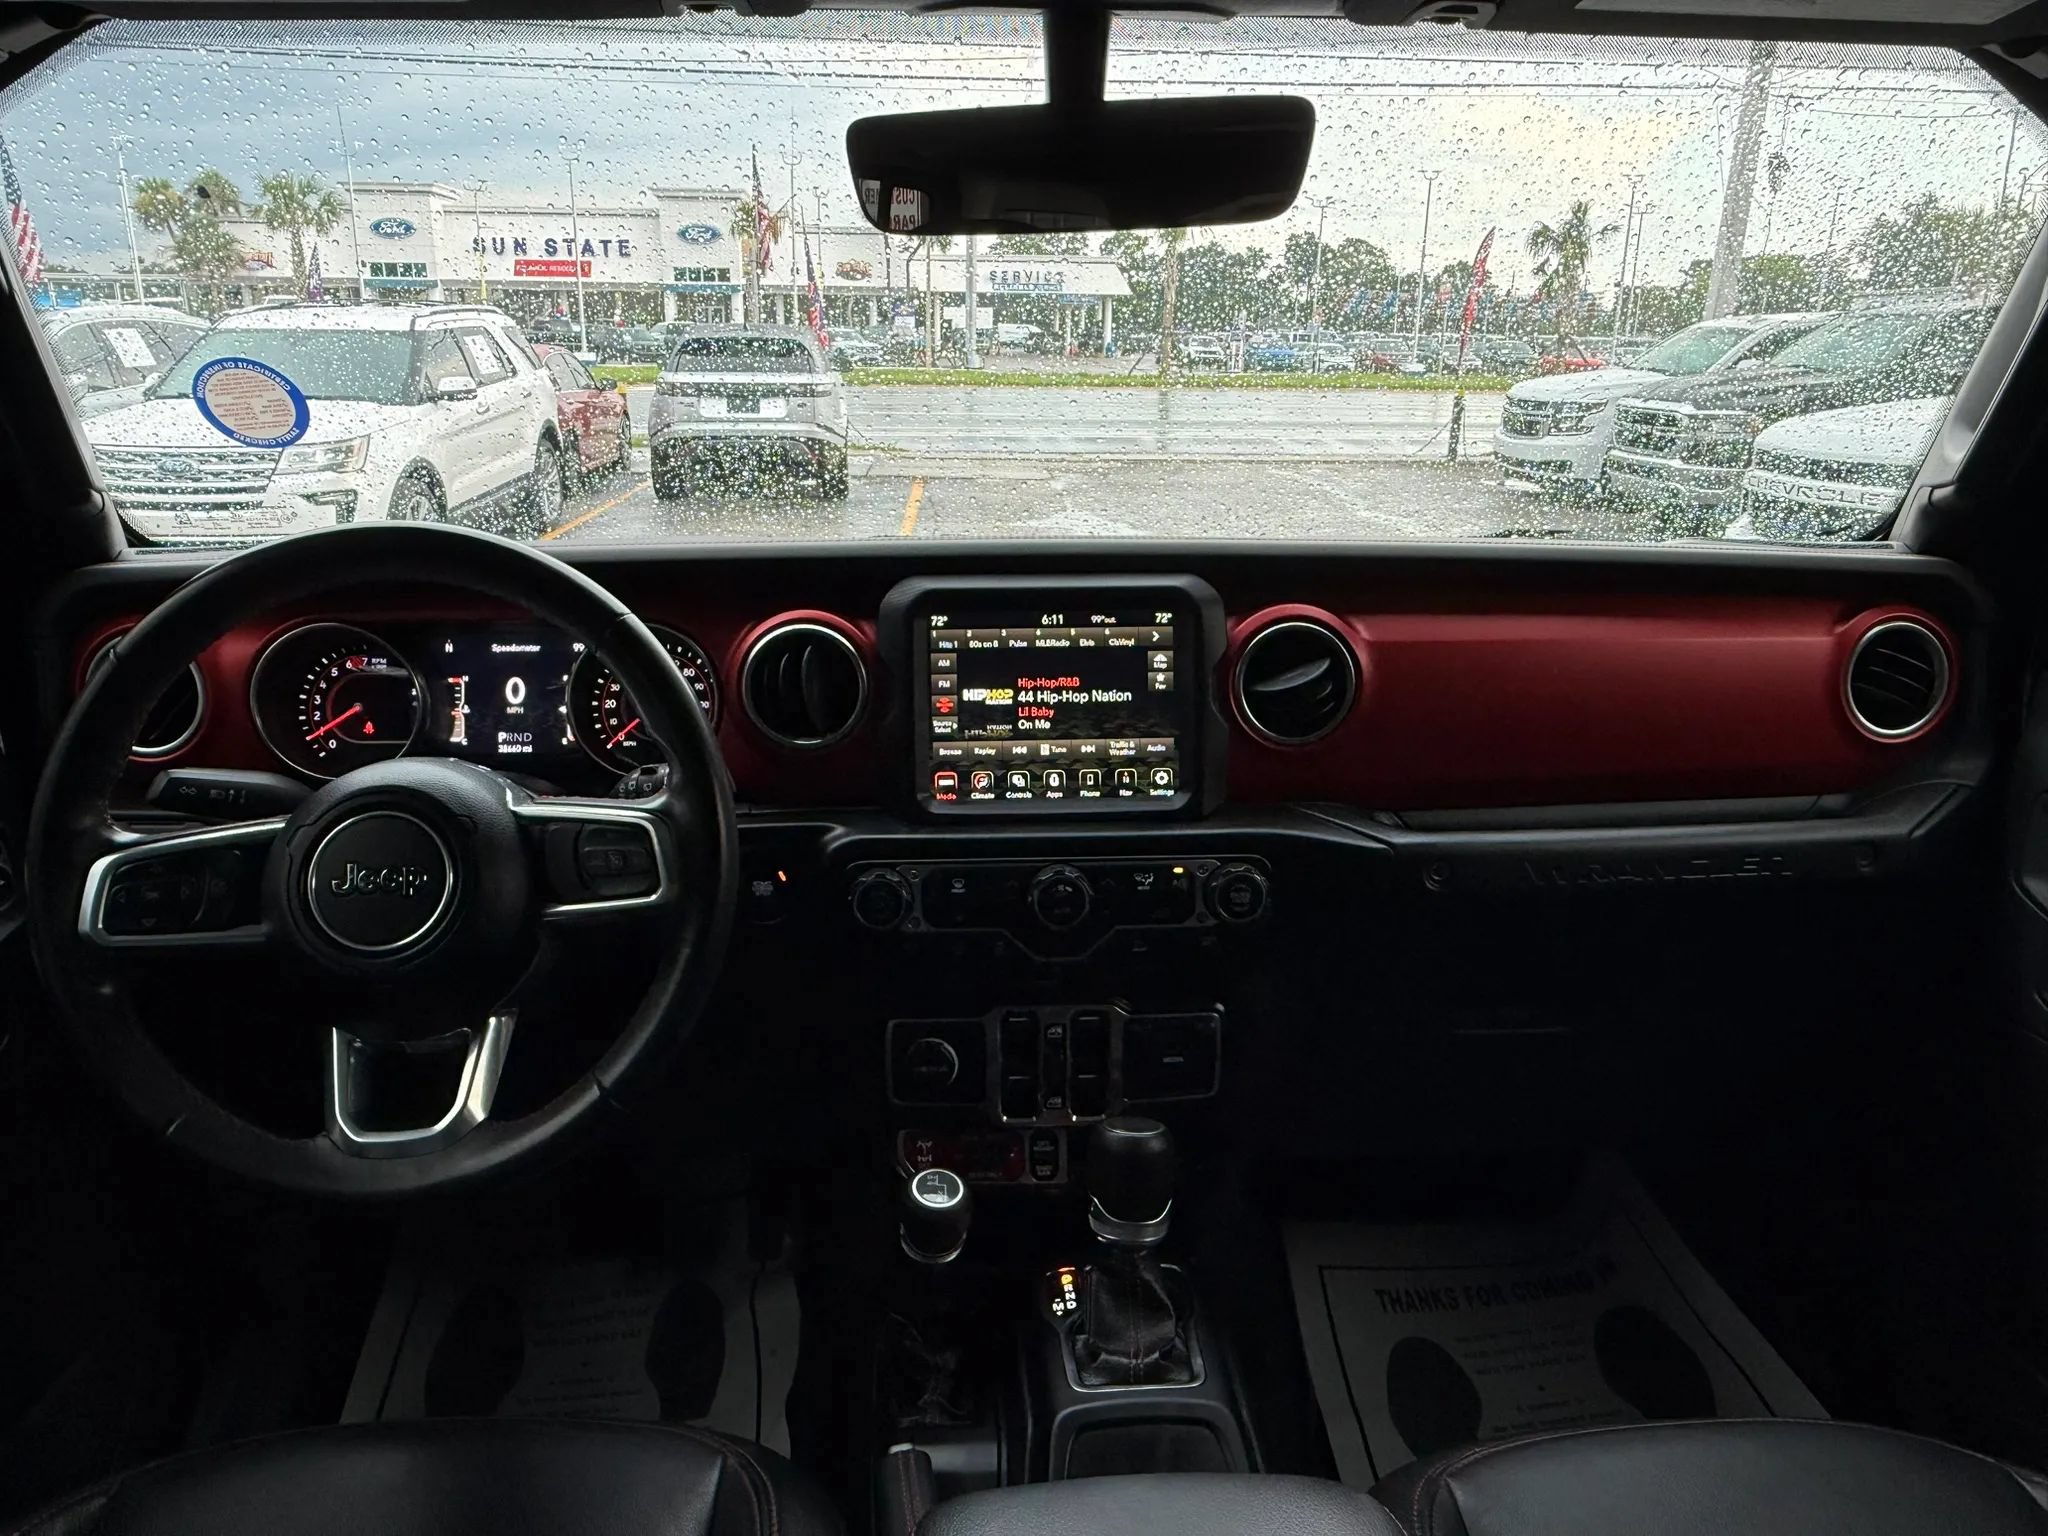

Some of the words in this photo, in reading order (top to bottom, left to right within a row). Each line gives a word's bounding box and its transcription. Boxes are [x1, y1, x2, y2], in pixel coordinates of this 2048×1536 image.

[472, 237, 528, 255] SUN
[544, 238, 631, 258] STATE
[1041, 614, 1064, 625] 6:11
[491, 644, 541, 653] Speedometer
[1009, 640, 1028, 648] Pulse
[345, 660, 352, 668] 6
[361, 657, 368, 666] 7
[938, 659, 951, 667] AM
[331, 668, 338, 677] 5
[683, 668, 695, 677] 80
[319, 680, 327, 689] 4
[938, 680, 951, 688] FM
[1017, 677, 1080, 689] Hip-Hop/R&B
[505, 676, 526, 705] 0
[314, 695, 321, 704] 3
[1017, 691, 1034, 702] 44
[1037, 690, 1089, 704] Hip-Hop
[1092, 689, 1132, 702] Nation
[605, 700, 616, 708] 20
[313, 712, 321, 720] 2
[1018, 706, 1029, 717] Lil
[1031, 706, 1054, 718] Baby
[1018, 720, 1033, 729] On
[1035, 719, 1051, 729] Me
[329, 739, 336, 748] 0
[1147, 744, 1166, 752] Audio
[1046, 791, 1063, 799] Apps
[331, 863, 428, 897] Jeep
[1373, 1287, 1460, 1314] THANKS
